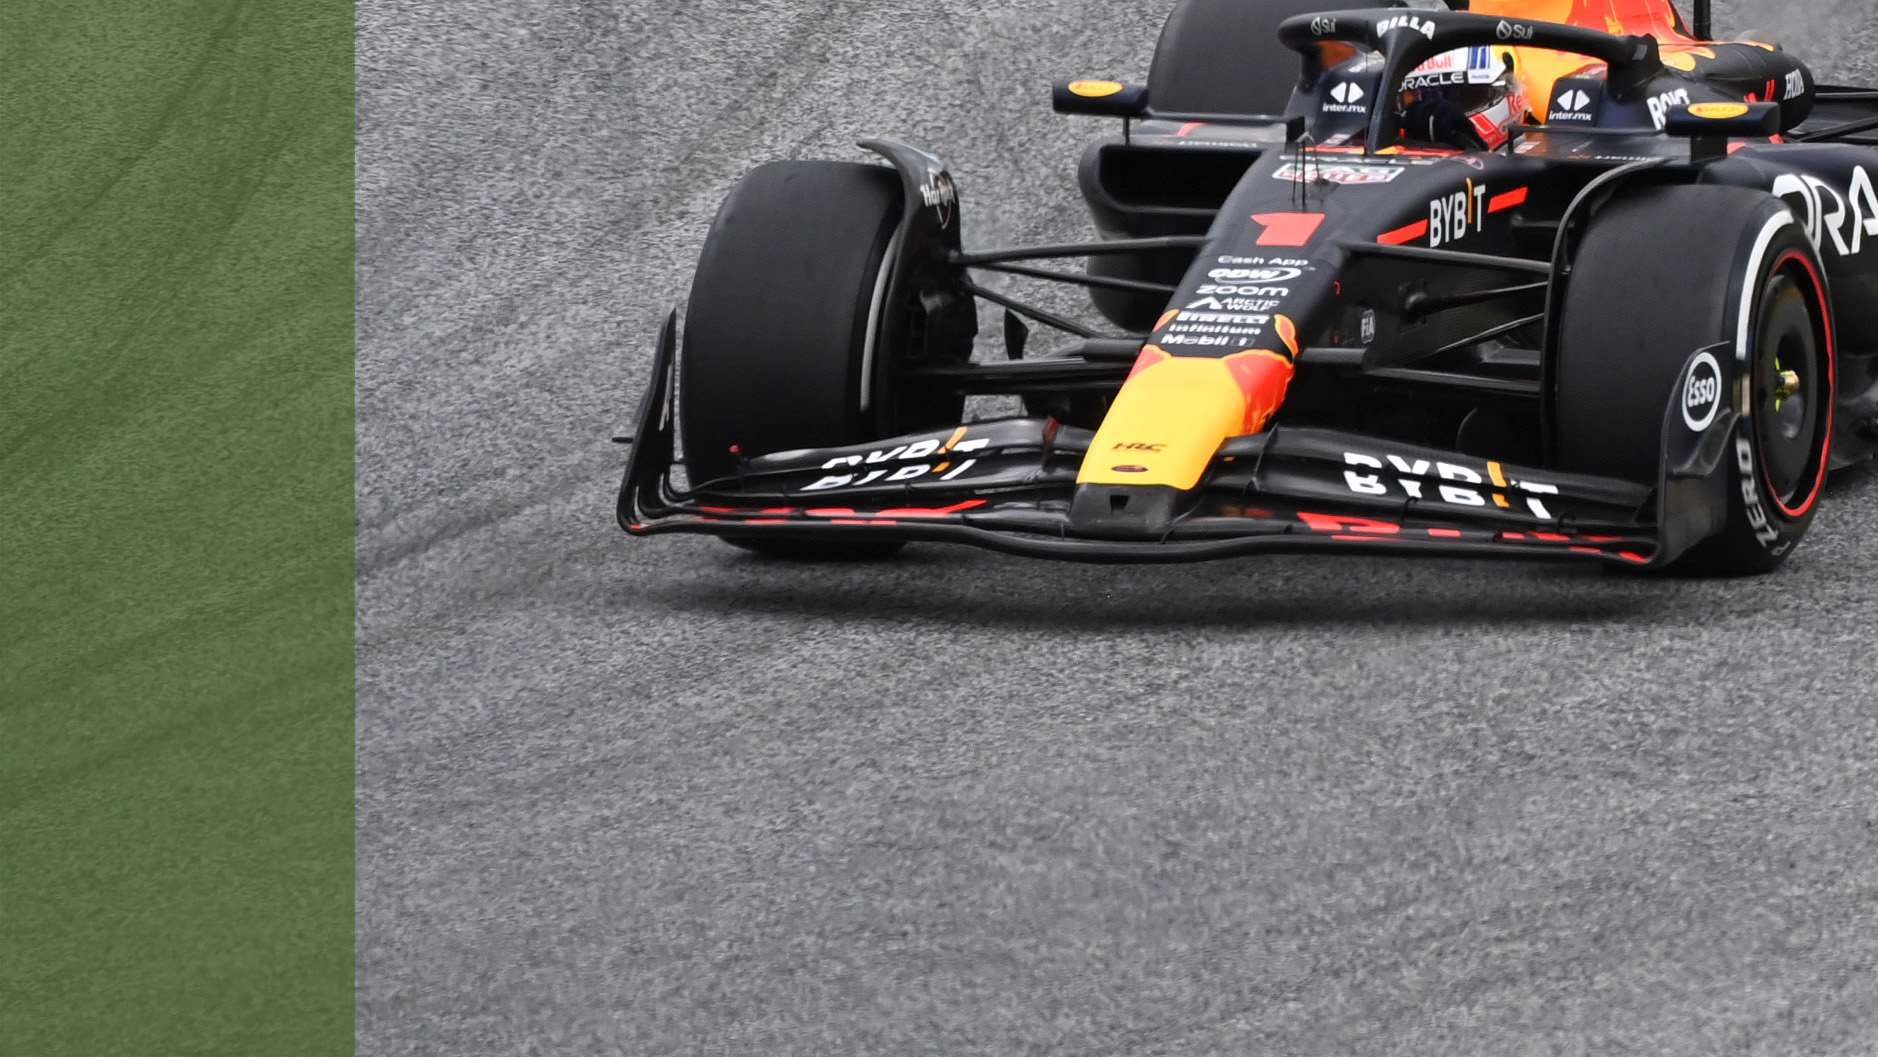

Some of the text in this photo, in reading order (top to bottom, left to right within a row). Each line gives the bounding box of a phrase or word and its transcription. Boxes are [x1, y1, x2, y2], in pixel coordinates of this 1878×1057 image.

[1322, 102, 1367, 115] inter.mx
[1548, 110, 1592, 122] inter.mx
[1429, 177, 1486, 248] BYBIT
[1250, 212, 1326, 247] 1
[1217, 255, 1309, 267] Cash App
[1196, 284, 1289, 297] zoom
[1221, 297, 1280, 307] ARCTIC
[1226, 303, 1272, 312] WOLF
[1176, 311, 1270, 325] PIRELLI
[1161, 333, 1230, 346] Mobil
